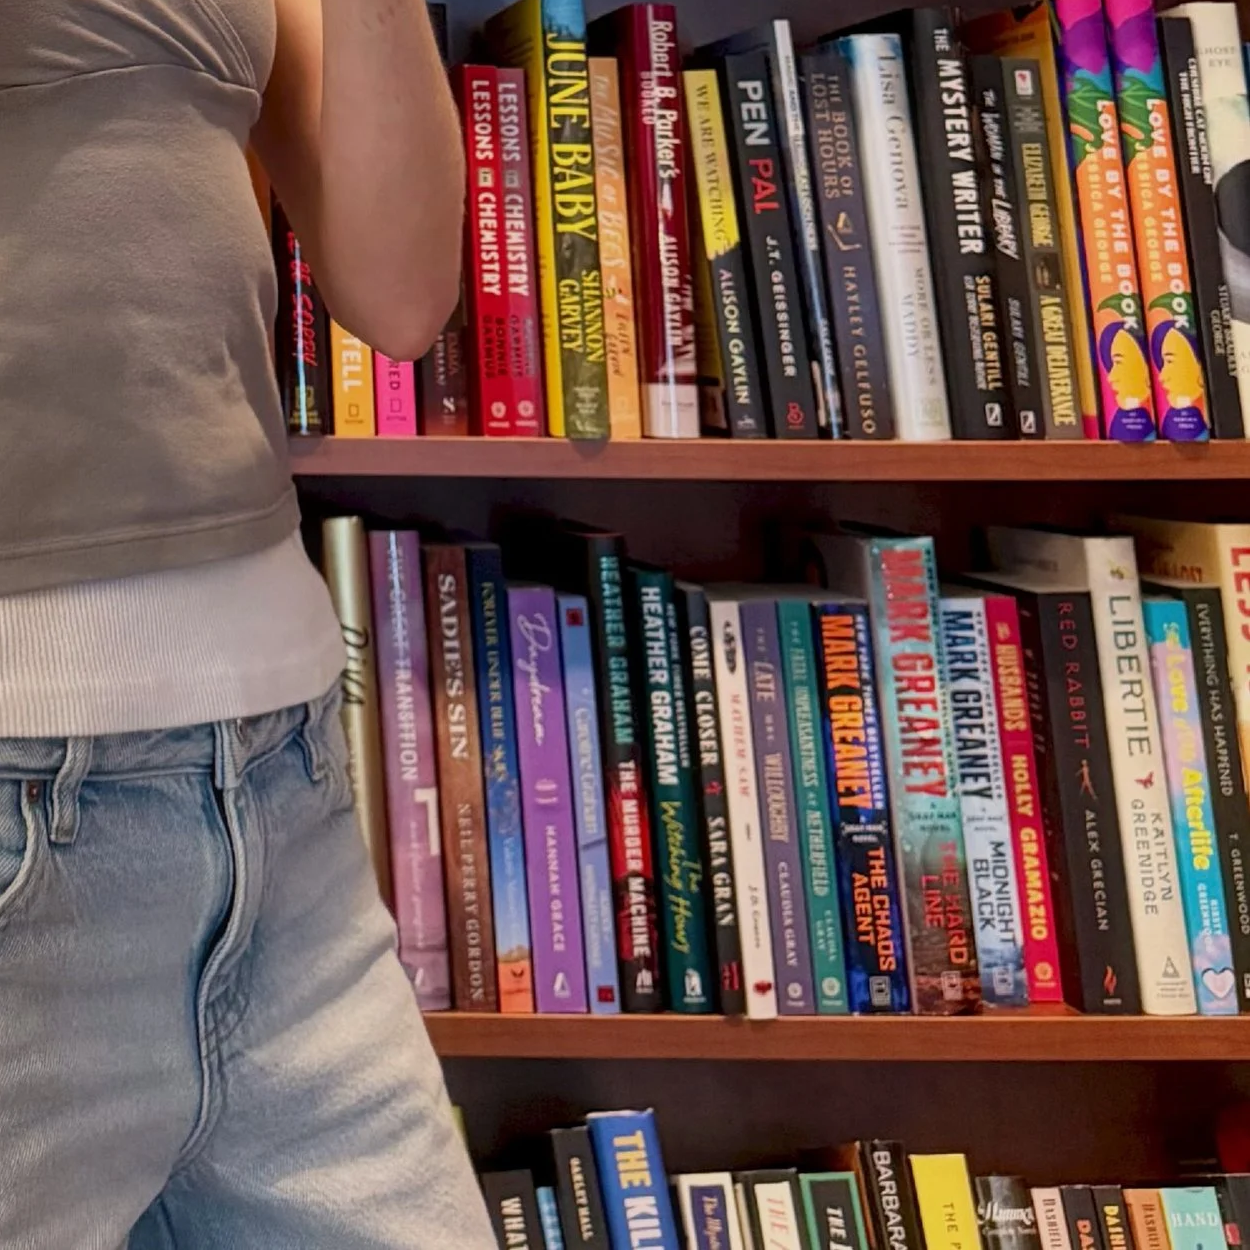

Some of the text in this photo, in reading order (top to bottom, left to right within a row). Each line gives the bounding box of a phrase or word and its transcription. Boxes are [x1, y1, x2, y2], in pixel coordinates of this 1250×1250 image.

[472, 81, 501, 296] LESSONS CHEMISTRY
[547, 34, 596, 240] JUNE BABY
[738, 80, 781, 214] PEN PAL
[934, 29, 986, 254] THE MYSTERY WRITER
[558, 280, 581, 352] GARVEY
[581, 271, 603, 362] SHANNON
[944, 611, 993, 800] MARK GREANEY
[1109, 596, 1152, 756] LIBERTIE
[545, 826, 566, 951] HANNAH GRACE
[973, 859, 996, 930] BLACK
[989, 842, 1017, 947] MIDNIGHT
[1010, 754, 1048, 940] HOLLY GRAMAZIO
[614, 1131, 647, 1187] THE
[1171, 1209, 1219, 1229] HAND
